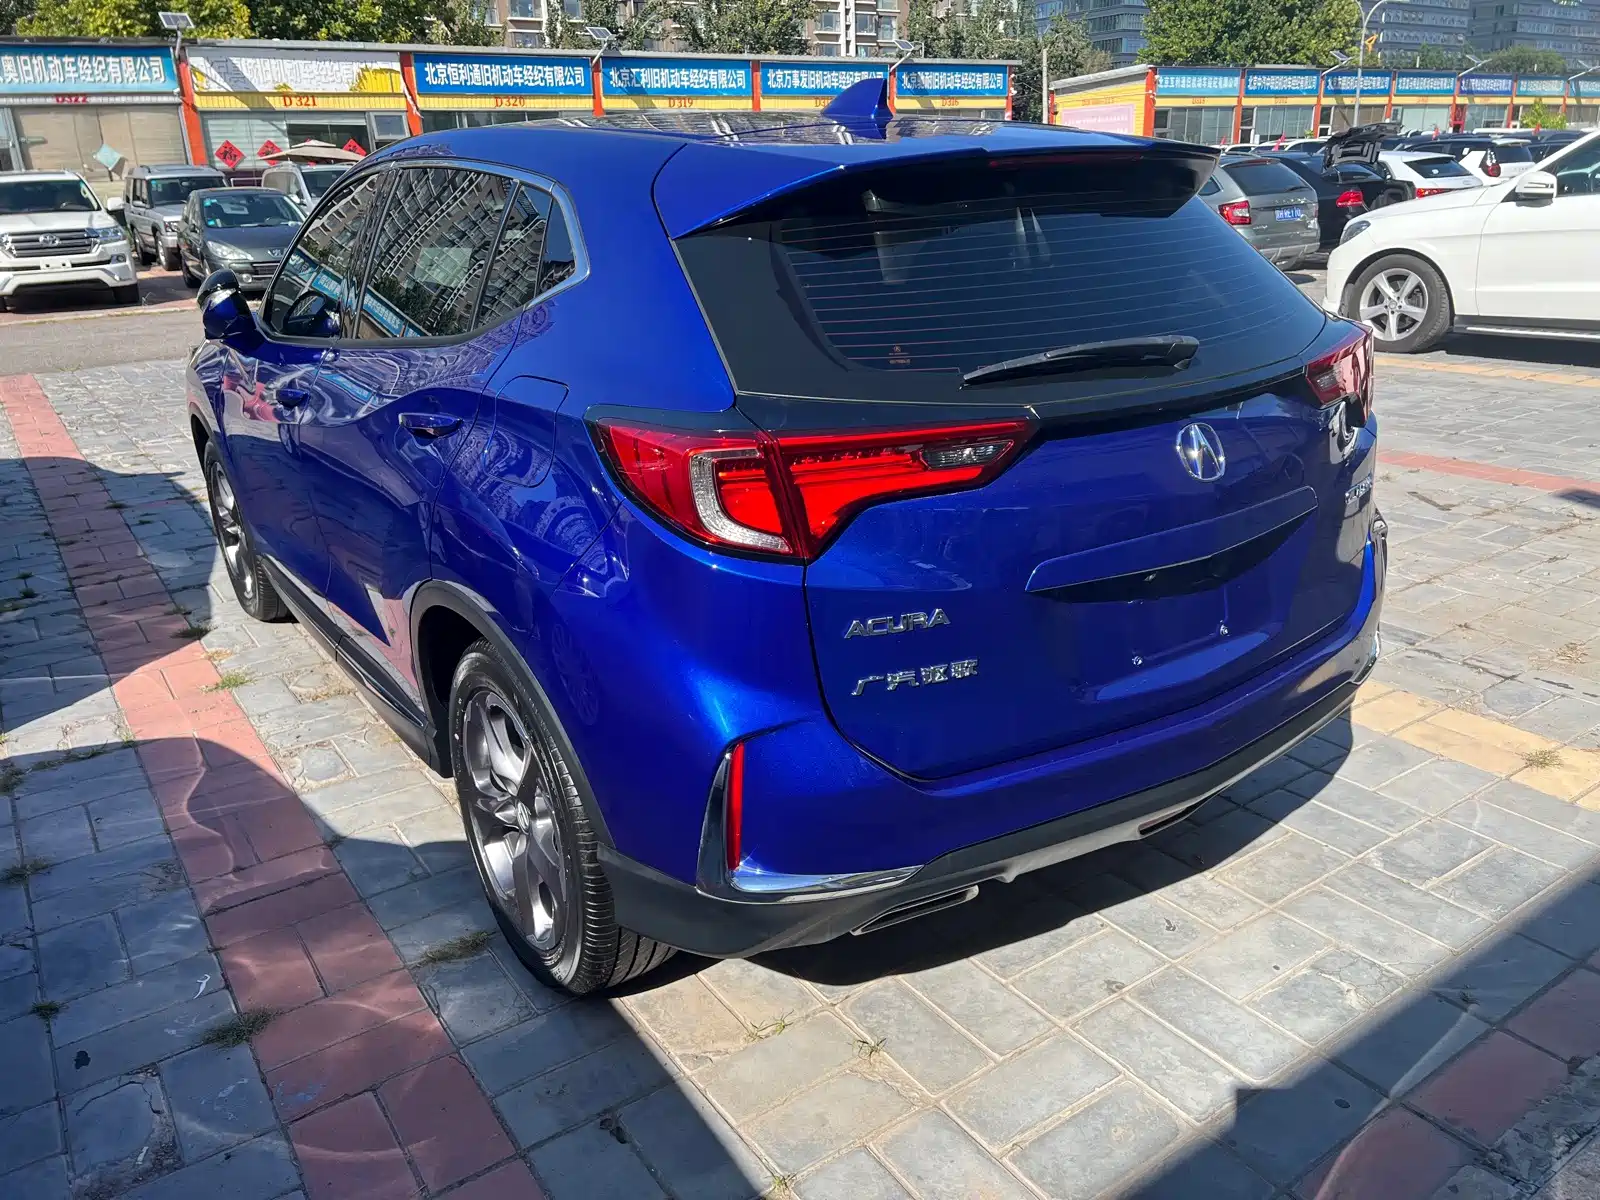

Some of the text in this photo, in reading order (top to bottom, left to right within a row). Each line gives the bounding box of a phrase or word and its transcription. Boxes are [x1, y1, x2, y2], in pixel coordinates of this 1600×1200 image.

[0, 54, 165, 84] 奥旧机动车经纪有限公司
[424, 62, 585, 87] 北京恒利通旧机动车经纪有限公司
[609, 67, 746, 89] 北京汇利旧机动车经纪有限公司
[494, 97, 526, 108] D320
[668, 98, 694, 108] D319
[844, 608, 951, 639] ACURA
[851, 658, 978, 696] 广汽讴歌
